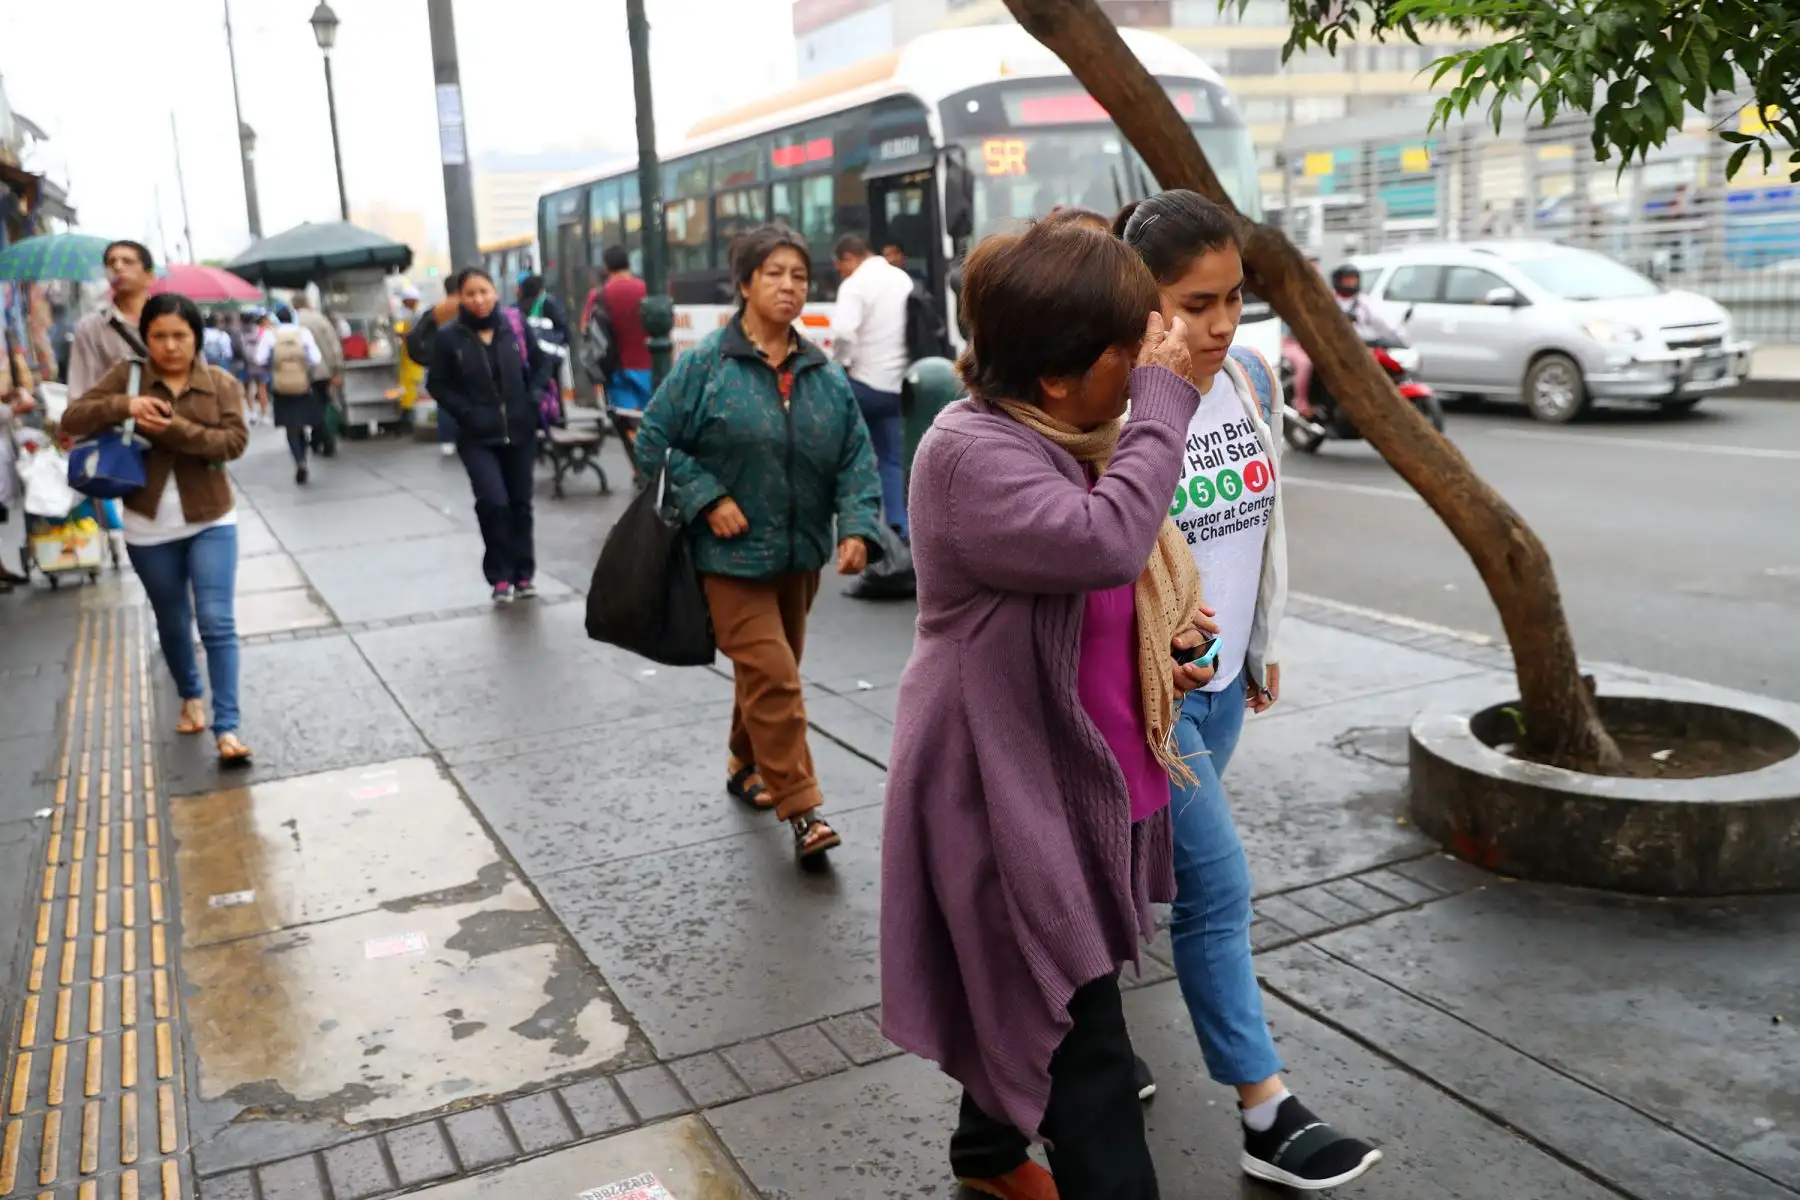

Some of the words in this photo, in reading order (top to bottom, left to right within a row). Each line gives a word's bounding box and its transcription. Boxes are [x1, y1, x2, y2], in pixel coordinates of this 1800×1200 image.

[1185, 431, 1222, 453] klyn
[1188, 447, 1225, 471] Hall
[1196, 481, 1210, 503] 5
[1222, 474, 1237, 496] 6
[1251, 465, 1264, 488] J
[1175, 511, 1221, 532] levator
[1224, 506, 1236, 520] at
[1186, 531, 1197, 545] &
[1200, 515, 1260, 542] Chambers
